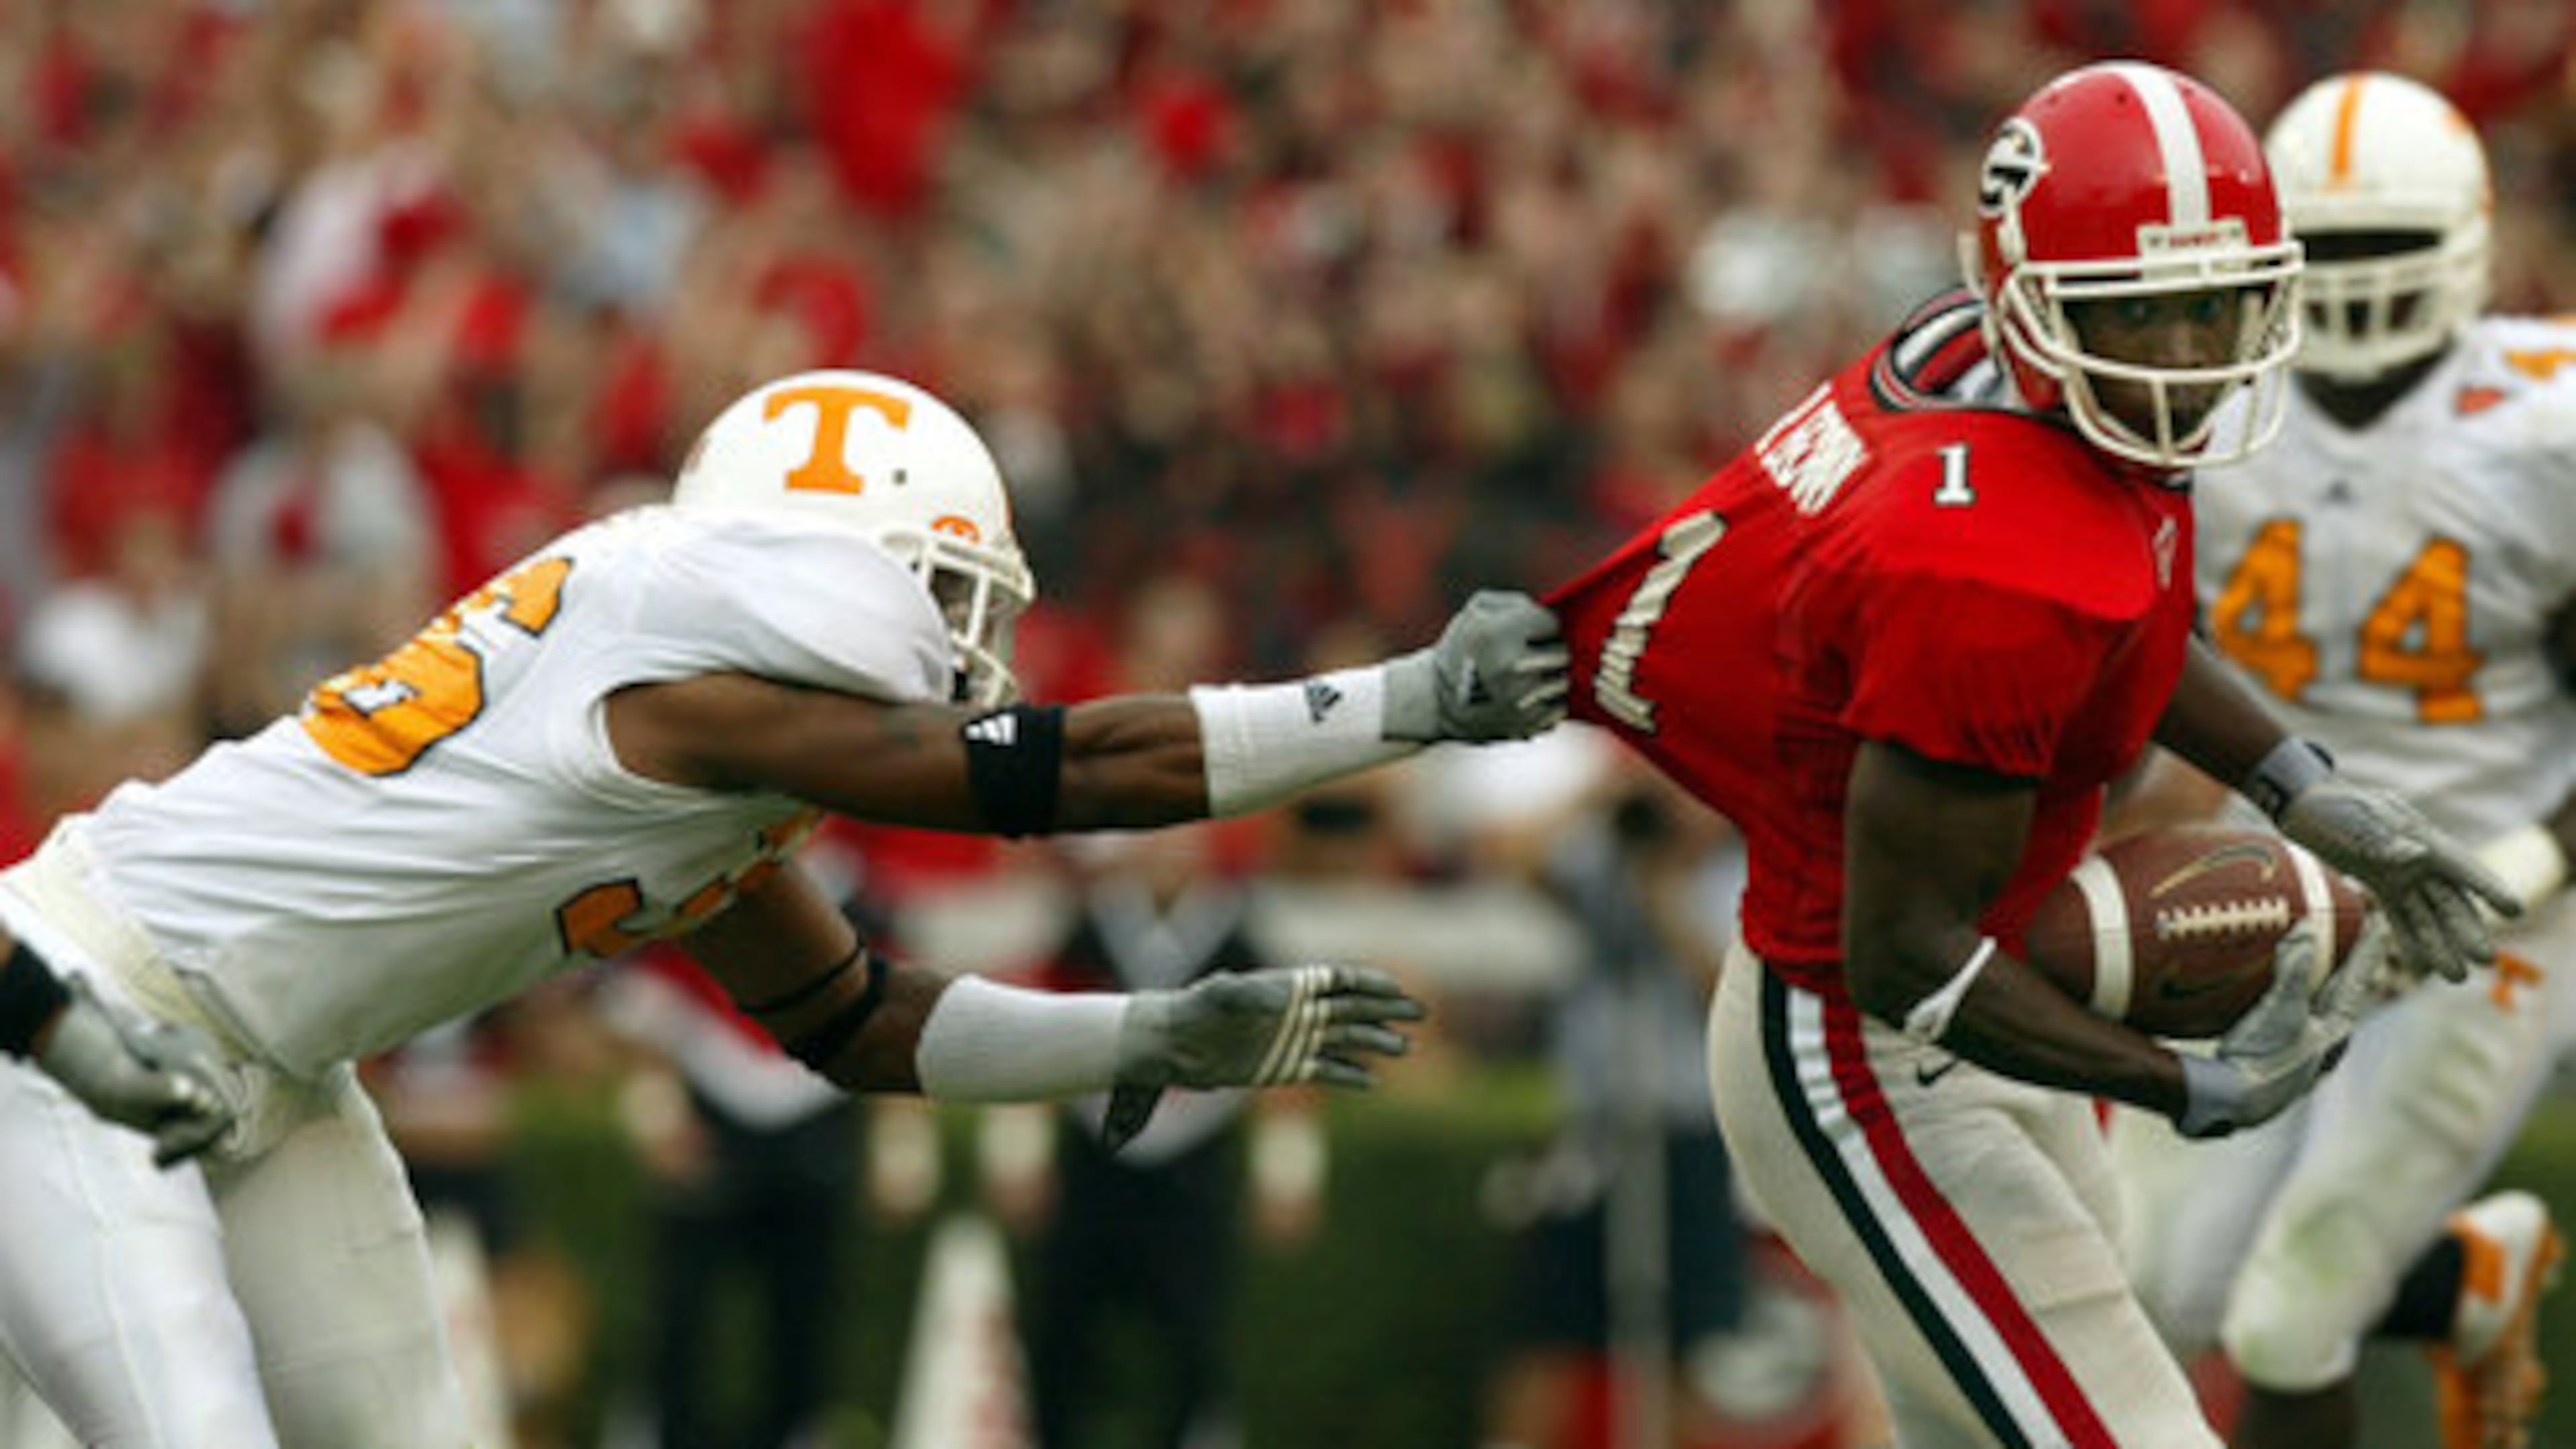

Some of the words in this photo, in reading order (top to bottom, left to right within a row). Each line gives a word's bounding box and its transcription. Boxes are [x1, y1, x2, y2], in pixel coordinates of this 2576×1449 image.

[763, 386, 910, 495] T
[1933, 443, 1976, 506] 1
[2215, 518, 2482, 724] 44
